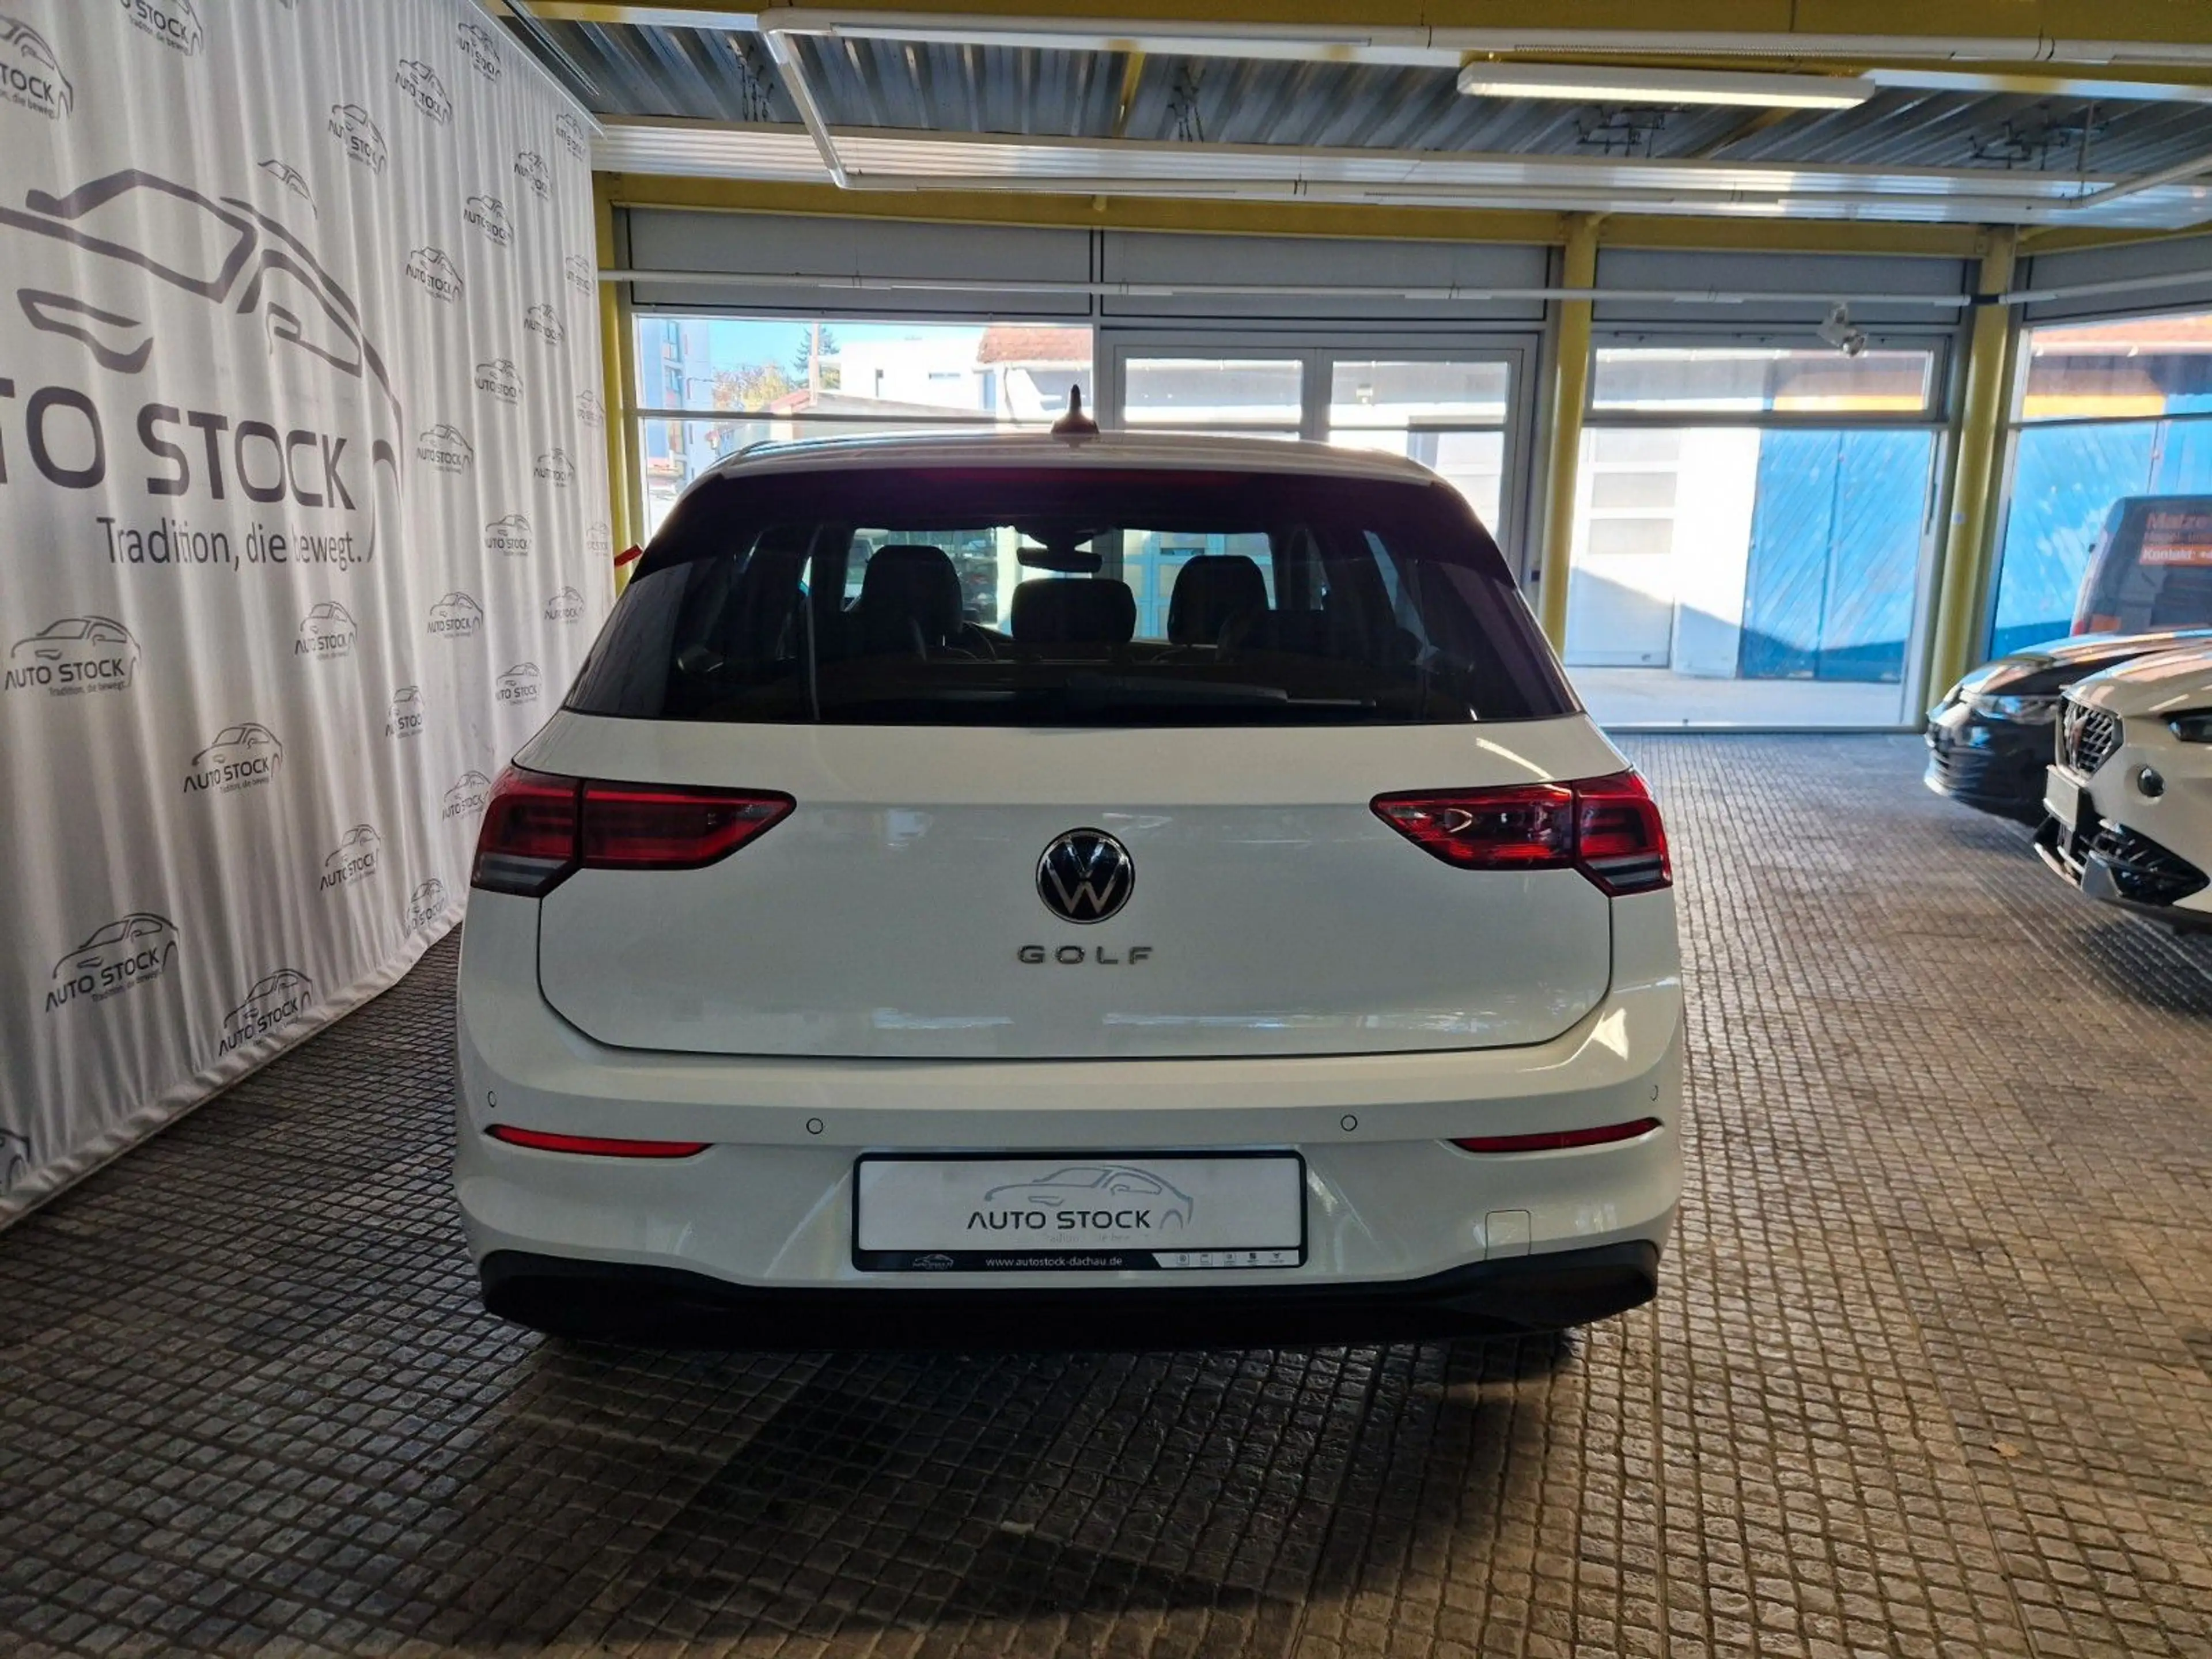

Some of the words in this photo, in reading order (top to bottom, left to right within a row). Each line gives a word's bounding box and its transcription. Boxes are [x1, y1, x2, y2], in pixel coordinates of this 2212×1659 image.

[135, 0, 189, 44] STOCK
[137, 403, 356, 510] STOCK
[96, 516, 240, 572] Tradition,
[246, 521, 287, 563] die
[5, 665, 52, 691] AUTO
[59, 658, 124, 683] STOCK
[184, 768, 221, 793] AUTO
[224, 756, 270, 781] STOCK
[1018, 945, 1153, 965] GOLF
[46, 975, 95, 1013] AUTO
[101, 947, 160, 987] STOCK
[219, 1024, 254, 1057] AUTO
[257, 997, 298, 1033] STOCK
[966, 1210, 1047, 1230] AUTO
[1056, 1209, 1152, 1229] STOCK
[985, 1256, 1123, 1267] www.autostock-dachau.de
